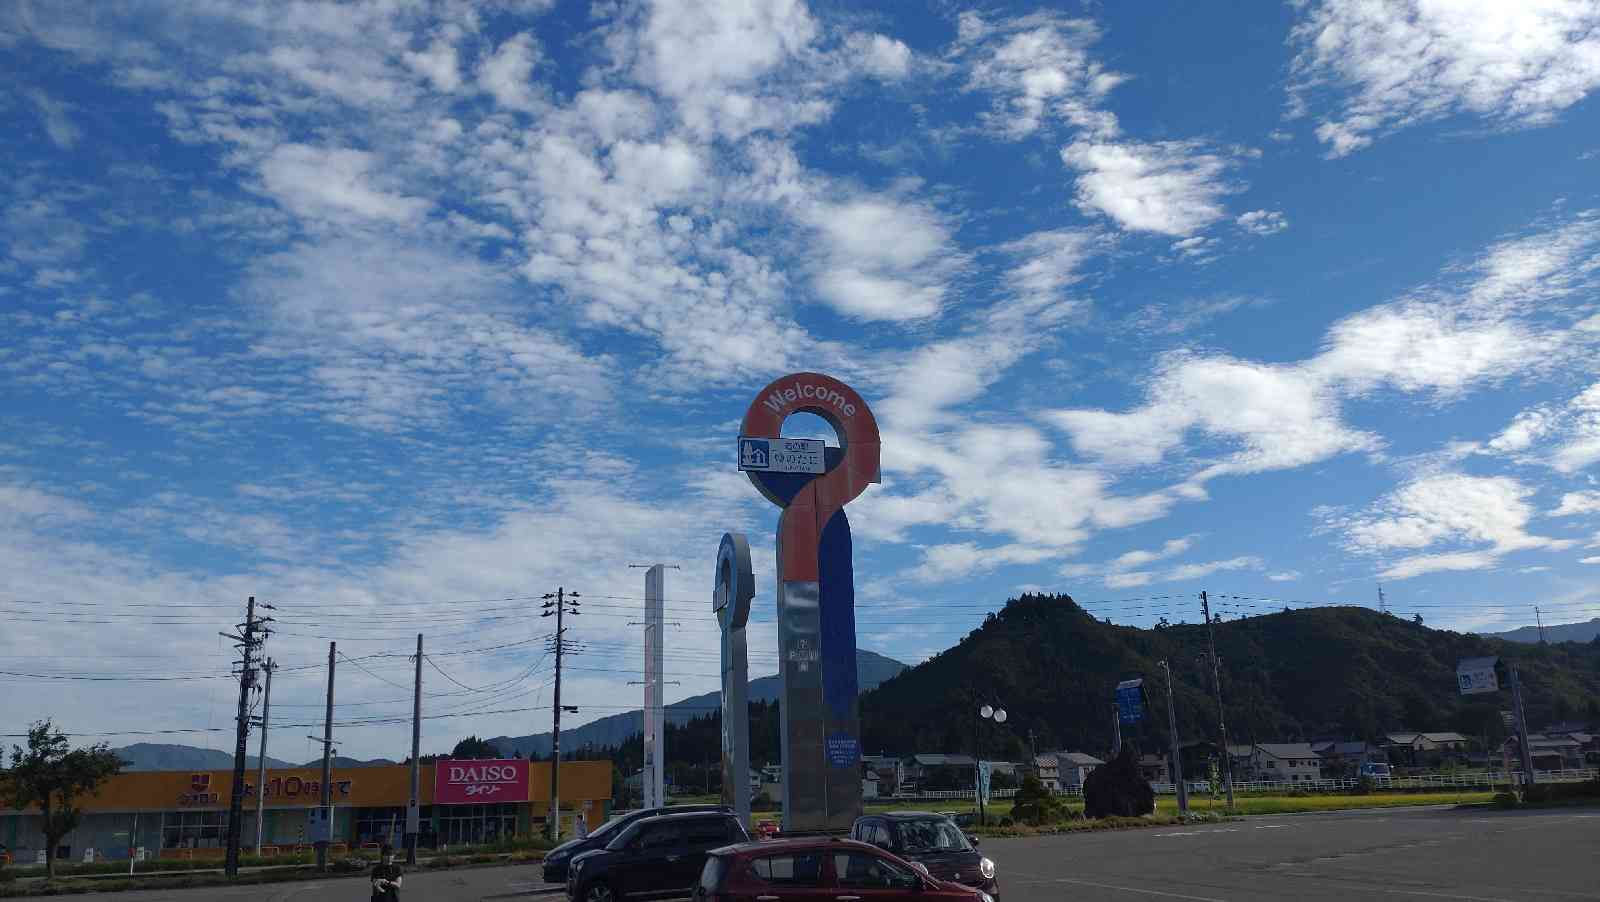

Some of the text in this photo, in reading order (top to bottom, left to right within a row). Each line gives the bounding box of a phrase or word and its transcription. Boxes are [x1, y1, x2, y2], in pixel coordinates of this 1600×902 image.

[763, 382, 856, 417] Welcome
[448, 766, 517, 782] DAISO
[465, 784, 502, 795] ダイソー
